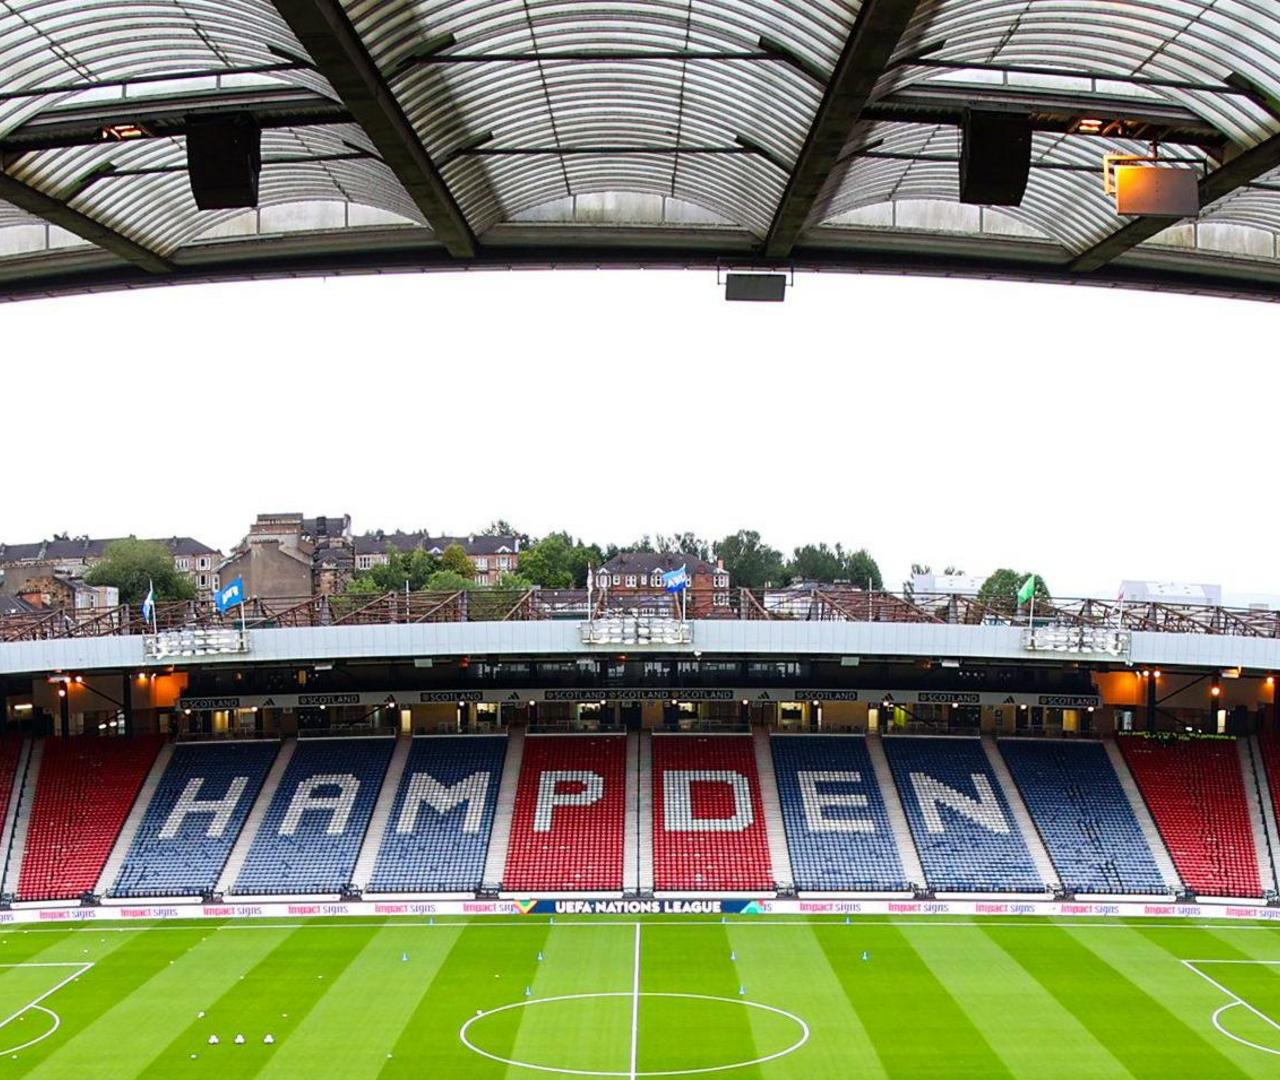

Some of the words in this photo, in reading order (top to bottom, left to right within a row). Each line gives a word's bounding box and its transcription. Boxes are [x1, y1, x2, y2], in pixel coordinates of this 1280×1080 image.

[306, 695, 358, 704] SCOTLAND
[430, 692, 481, 701] SCOTLAND
[804, 691, 856, 700] SCOTLAND
[927, 692, 979, 703] SCOTLAND
[1047, 696, 1097, 706] SCOTLAND
[158, 770, 1010, 840] HAMPDEN
[555, 901, 591, 914] UEFA
[595, 901, 662, 914] NATIONS
[664, 901, 721, 914] LEAGUE
